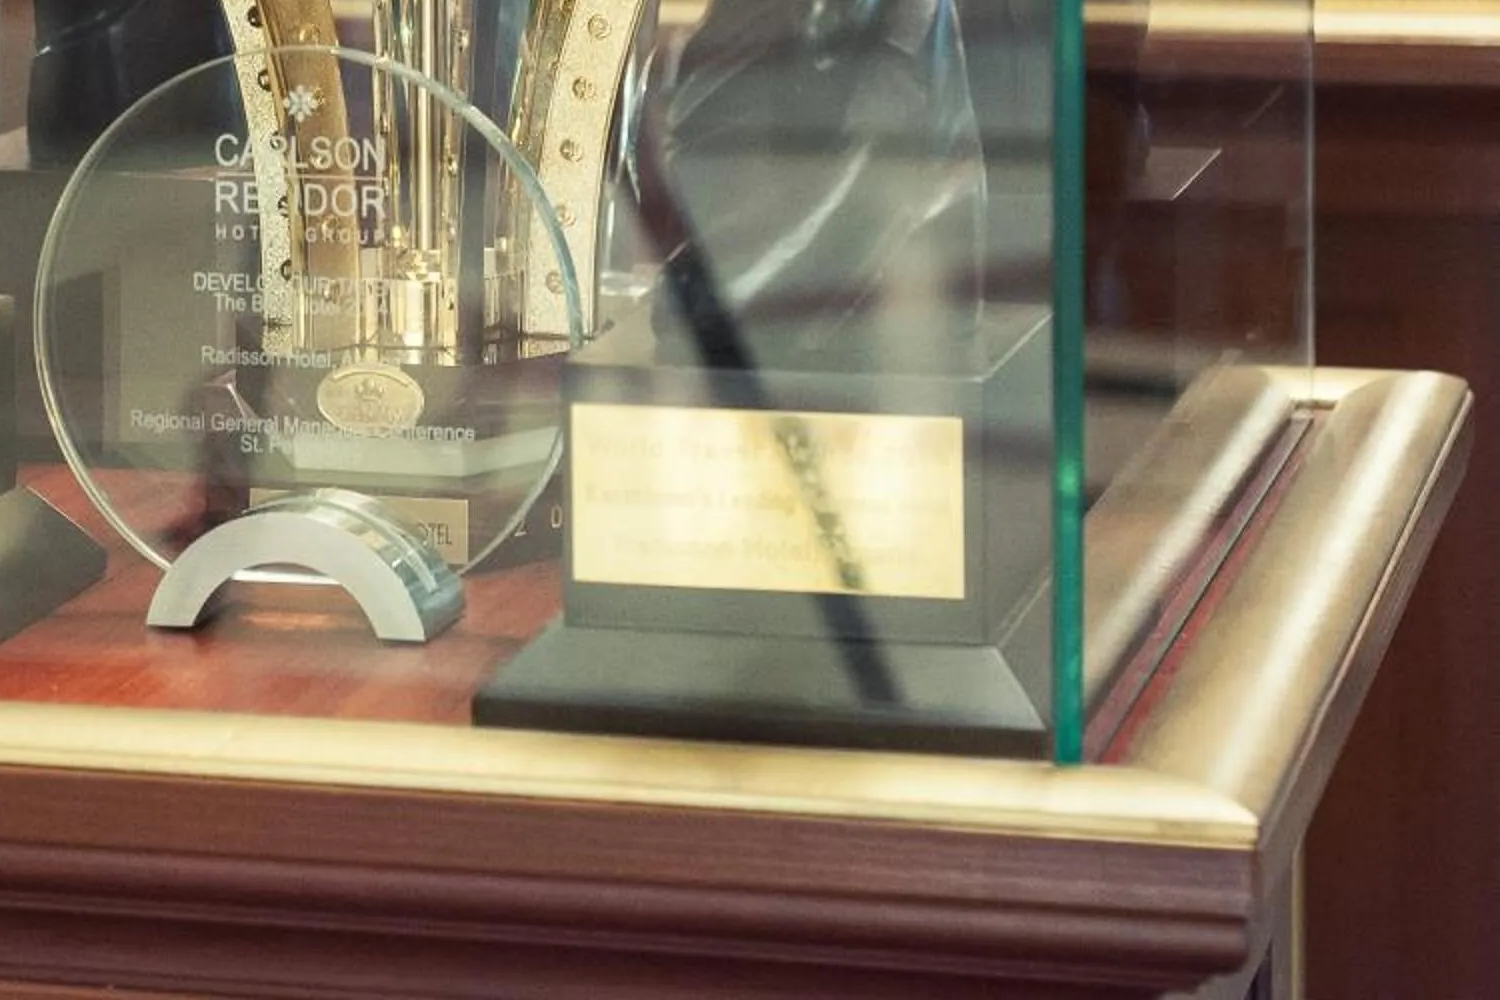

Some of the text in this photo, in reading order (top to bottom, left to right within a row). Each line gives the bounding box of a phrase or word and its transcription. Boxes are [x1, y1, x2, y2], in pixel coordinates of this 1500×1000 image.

[214, 181, 386, 220] REIDOR
[215, 223, 261, 242] HOT
[214, 292, 247, 313] The
[201, 345, 280, 366] Radisson
[131, 409, 205, 434] Regional
[211, 412, 278, 433] General
[240, 433, 264, 453] St.
